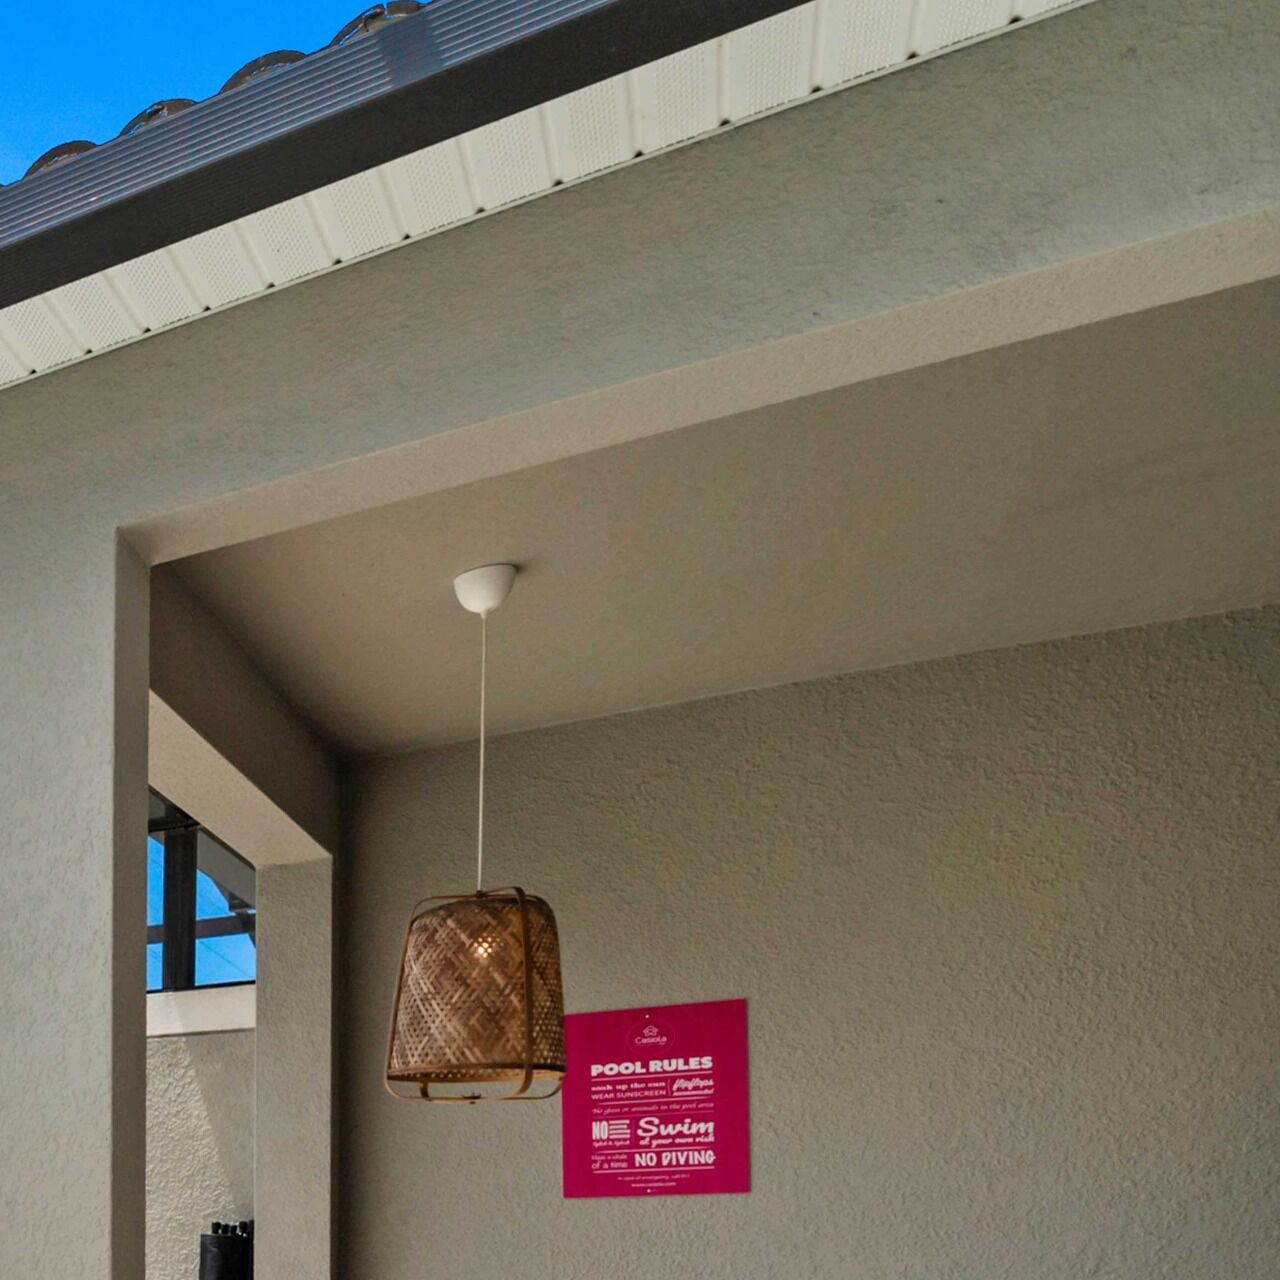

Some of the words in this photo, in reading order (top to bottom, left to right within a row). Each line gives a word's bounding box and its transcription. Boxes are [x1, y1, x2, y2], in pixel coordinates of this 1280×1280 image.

[591, 1061, 646, 1076] POOL
[649, 1056, 713, 1072] RULES
[591, 1092, 615, 1100] WEAR
[617, 1090, 666, 1099] SUNSCREEN
[616, 1083, 628, 1091] up
[592, 1121, 608, 1140] NO
[637, 1117, 714, 1137] Swim
[651, 1138, 672, 1148] your
[695, 1134, 714, 1143] risk
[591, 1160, 601, 1169] of
[634, 1153, 657, 1168] NO
[661, 1150, 716, 1166] DIVING
